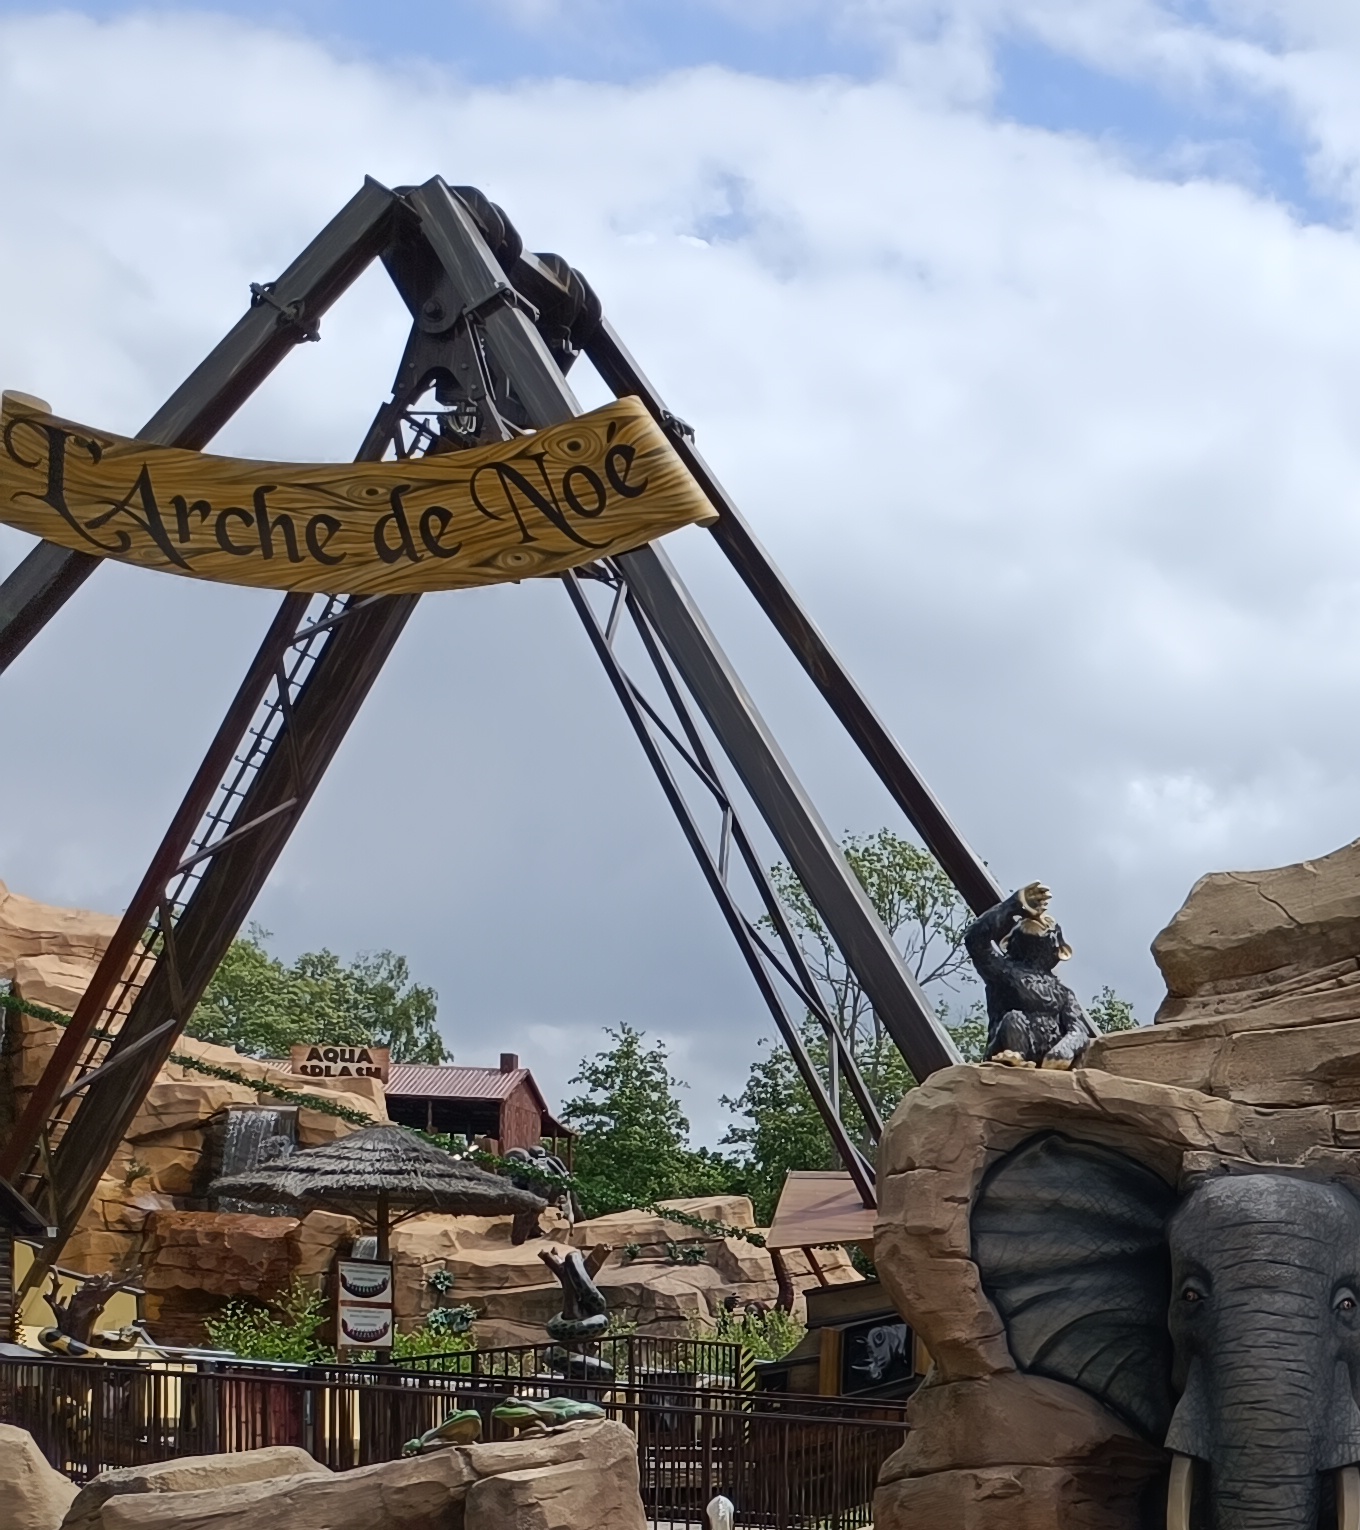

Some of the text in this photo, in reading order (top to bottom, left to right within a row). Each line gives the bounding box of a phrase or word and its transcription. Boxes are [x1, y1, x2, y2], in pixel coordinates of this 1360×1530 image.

[3, 417, 649, 572] L'Arche de Noé
[306, 1047, 374, 1064] AQUA
